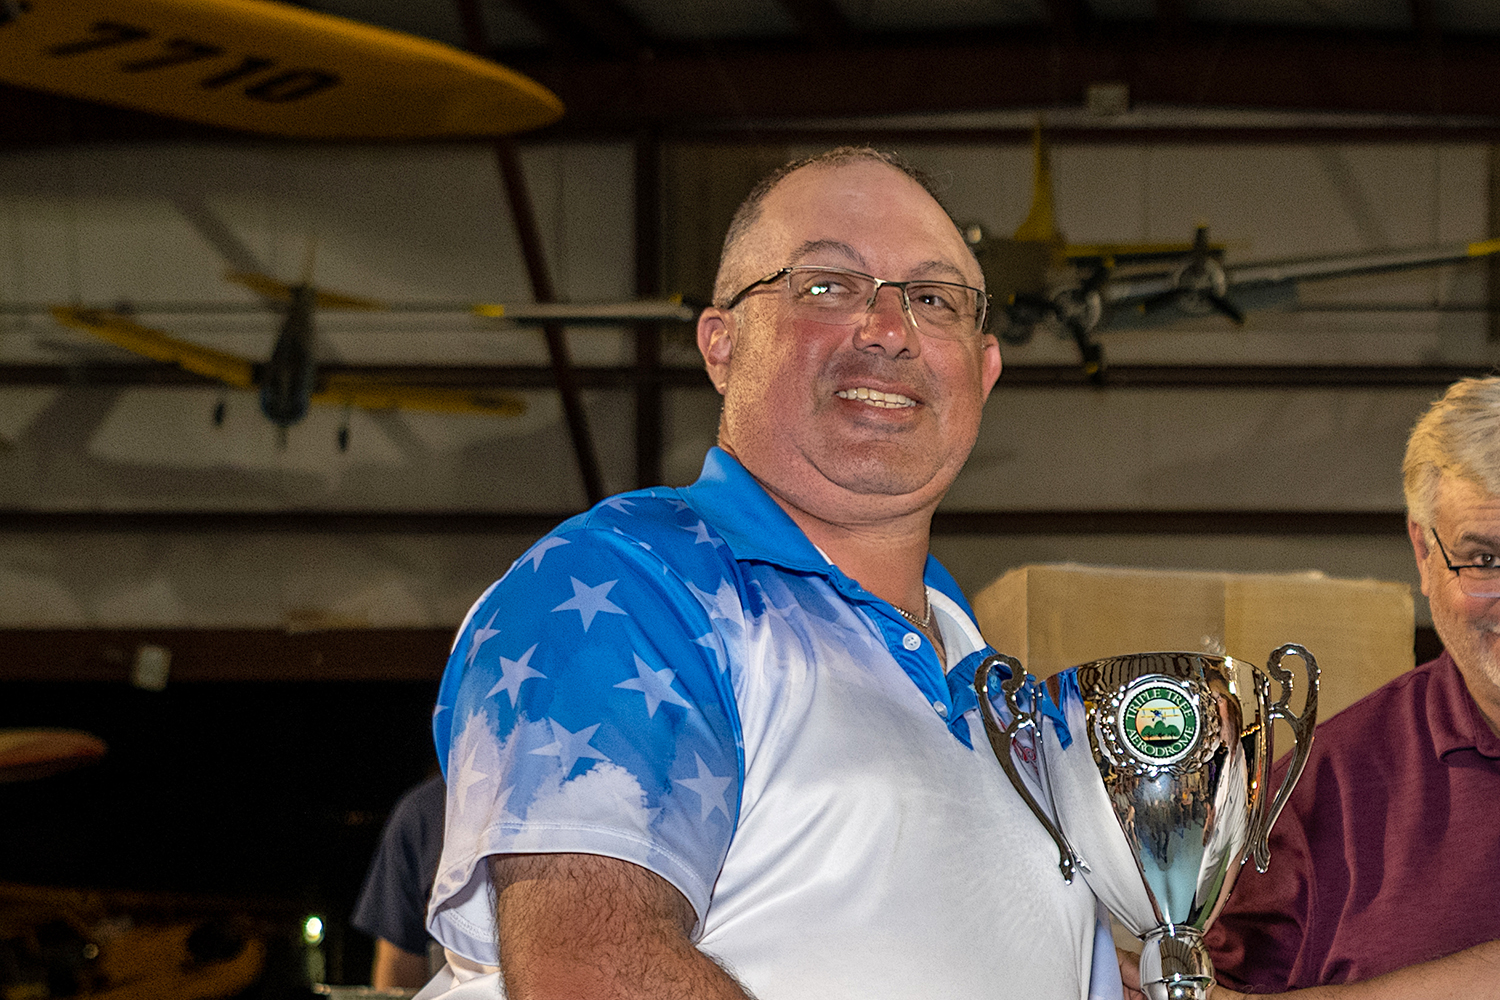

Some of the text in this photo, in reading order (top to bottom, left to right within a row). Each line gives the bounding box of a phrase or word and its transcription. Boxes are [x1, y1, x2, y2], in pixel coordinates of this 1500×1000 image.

[43, 19, 344, 104] 7710
[1126, 688, 1194, 718] TRIPLE TREE
[1126, 725, 1195, 757] AERODROME
